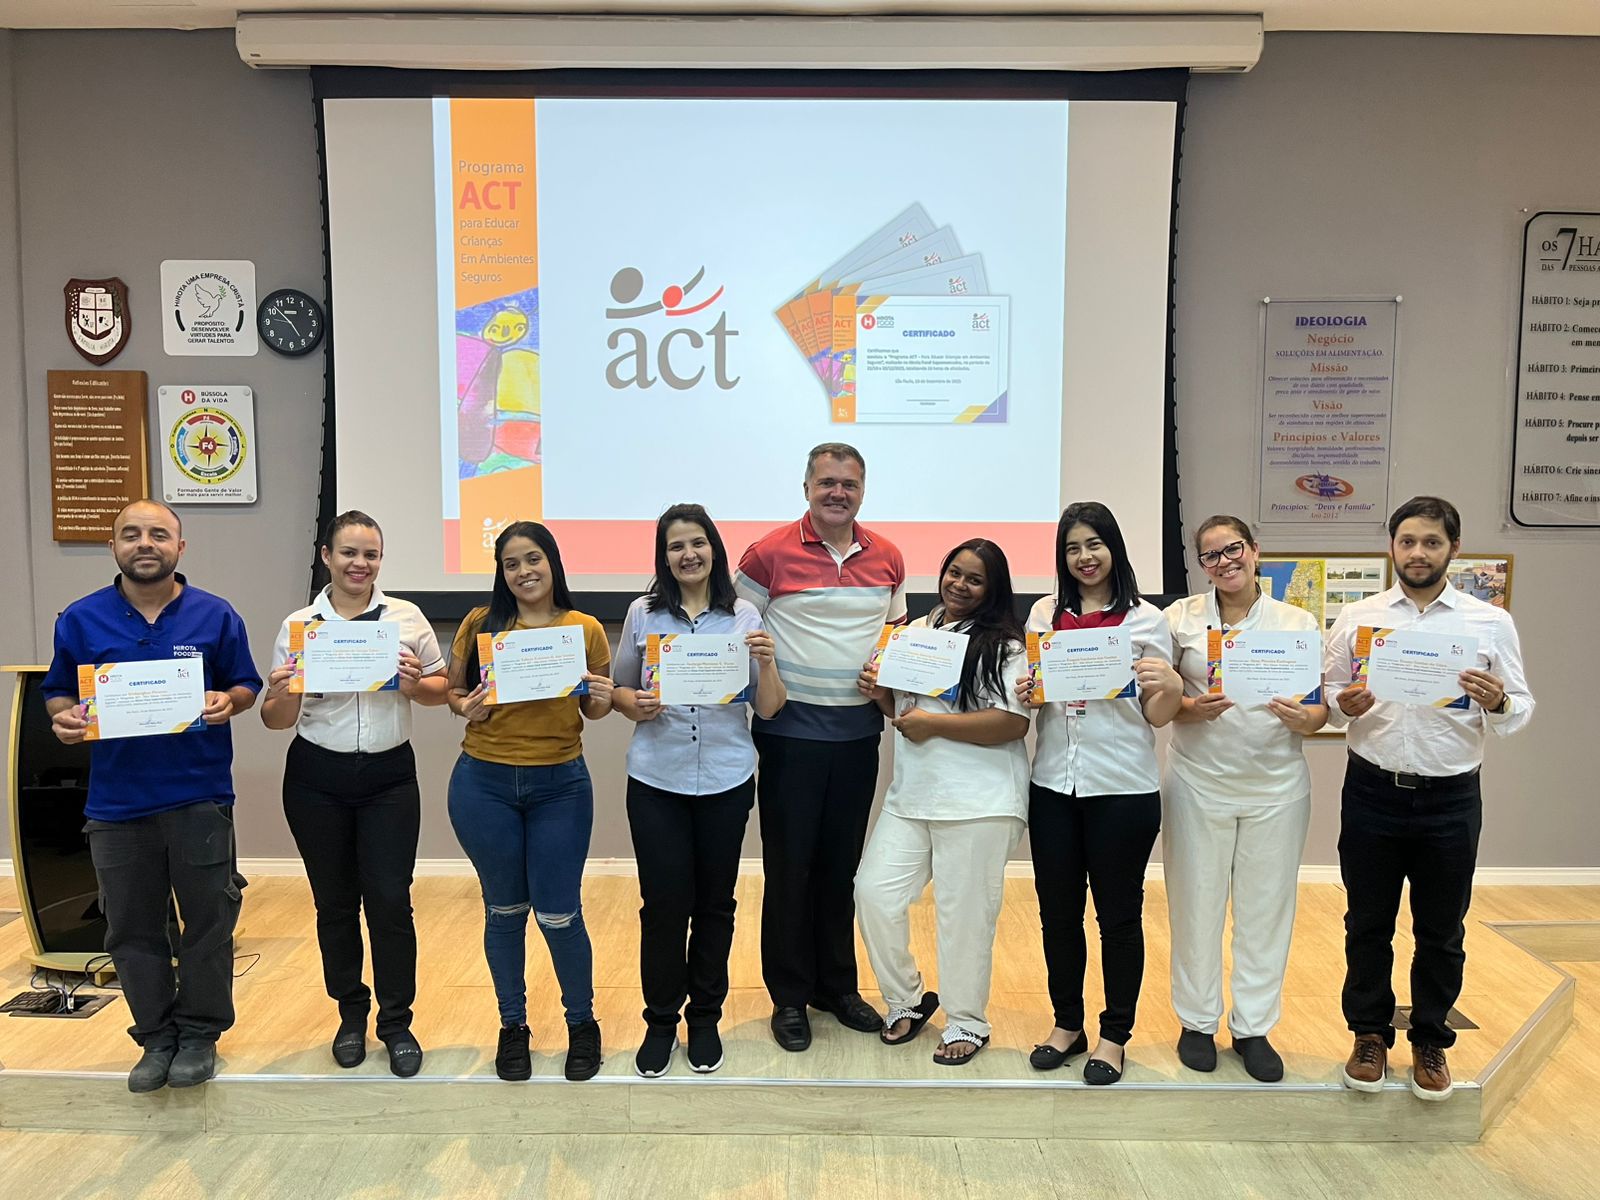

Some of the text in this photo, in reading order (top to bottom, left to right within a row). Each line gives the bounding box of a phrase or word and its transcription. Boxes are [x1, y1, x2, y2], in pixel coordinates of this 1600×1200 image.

[458, 159, 524, 176] Programa
[460, 180, 522, 210] ACT
[460, 217, 520, 230] para Educar
[460, 236, 503, 248] Crianças
[1541, 240, 1558, 252] OS
[1556, 228, 1577, 270] 7
[460, 253, 534, 264] Em Ambientes
[1568, 264, 1596, 272] PESSOAS
[461, 271, 502, 284] Seguros
[174, 284, 188, 307] HIROTA
[185, 275, 200, 286] UMA
[200, 272, 231, 286] EMPRESA
[1531, 295, 1564, 305] HÁBITO
[1565, 297, 1571, 305] 1:
[1573, 297, 1590, 308] Seja
[834, 320, 853, 328] ACT
[971, 318, 990, 329] act
[1295, 316, 1367, 327] IDEOLOGIA
[1530, 322, 1562, 332] HÁBITO
[1563, 323, 1570, 332] 2:
[301, 338, 305, 346] 5
[1307, 333, 1354, 347] Negócio
[605, 310, 741, 391] act
[1275, 349, 1314, 358] SOLUÇÕES
[1310, 362, 1349, 373] Missão
[1527, 362, 1560, 373] HÁBITO
[1561, 364, 1567, 373] 3:
[1526, 389, 1558, 400] HÁBITO
[1560, 392, 1566, 400] 4:
[1569, 393, 1590, 401] Pense
[1312, 400, 1343, 410] Visão
[1525, 417, 1557, 427] HÁBITO
[1558, 419, 1565, 428] 5:
[1567, 420, 1593, 428] Procure
[1273, 432, 1327, 444] Princípios
[1340, 431, 1380, 441] Valores
[1566, 433, 1588, 444] depois
[1523, 463, 1555, 474] HÁBITO
[1556, 466, 1563, 474] 6:
[1565, 466, 1582, 475] Crie
[1522, 491, 1554, 501] HÁBITO
[1555, 493, 1562, 501] 7:
[1564, 494, 1583, 502] Afine
[1271, 503, 1309, 512] Princípios:
[1314, 503, 1336, 511] "Deus
[1344, 503, 1375, 511] Família"
[521, 645, 553, 653] CERTIFICADO
[1402, 649, 1439, 658] CERTIFICADO
[177, 671, 190, 679] act
[128, 679, 167, 687] CERTIFICADO
